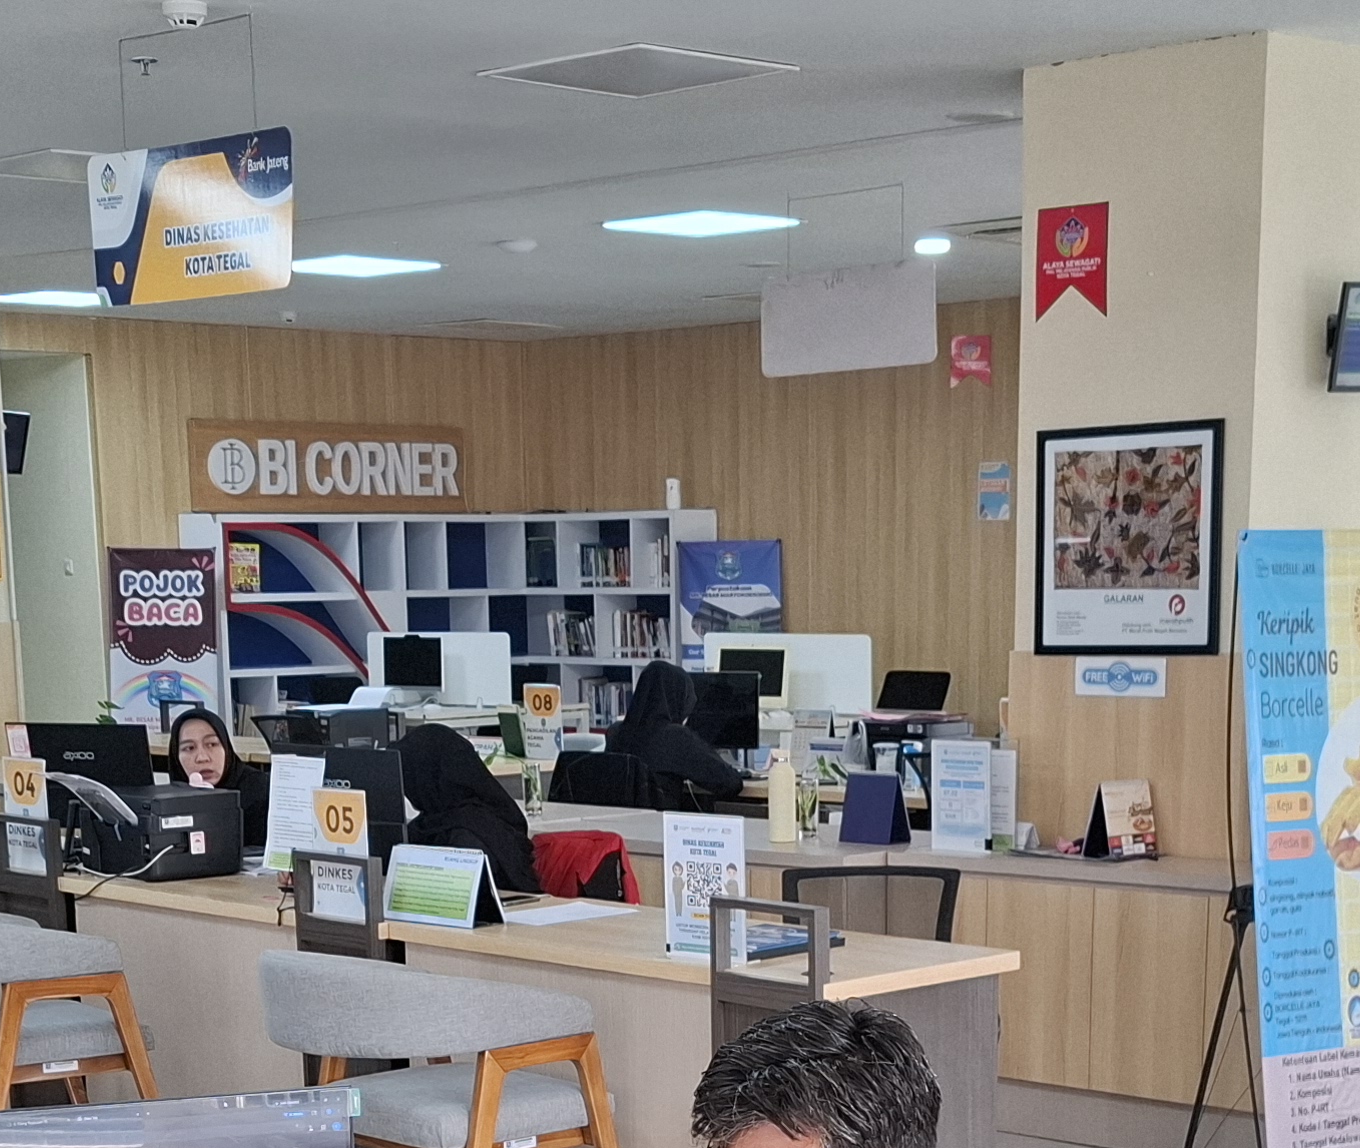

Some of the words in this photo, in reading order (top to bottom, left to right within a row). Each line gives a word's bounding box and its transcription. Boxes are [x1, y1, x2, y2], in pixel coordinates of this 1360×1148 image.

[247, 158, 265, 172] Bank
[266, 155, 289, 173] Jateng
[164, 225, 200, 246] DINAS
[203, 215, 270, 242] KESEHATAN
[185, 254, 214, 275] KOTA
[216, 252, 251, 271] TEGAL
[1043, 261, 1064, 270] ALAYA
[257, 439, 298, 496] BI
[304, 441, 459, 496] CORNER
[123, 572, 202, 594] POJOK
[1104, 594, 1144, 603] GALARAN
[128, 601, 199, 623] BACA
[1257, 607, 1315, 645] Keripik
[1259, 650, 1338, 678] SINGKONG
[1086, 671, 1108, 683] FREE
[1132, 671, 1154, 683] WiFi
[532, 694, 553, 711] 08
[1261, 690, 1324, 719] Borcelle
[13, 771, 35, 799] 04
[1277, 801, 1293, 811] Keju
[325, 805, 354, 834] 05
[8, 824, 36, 838] DINKES
[318, 865, 353, 880] DINKES
[317, 883, 334, 893] KOTA
[336, 883, 356, 894] TEGAL
[1282, 1055, 1318, 1067] Ketentuan
[1319, 1051, 1339, 1062] Label
[1296, 1072, 1316, 1081] Nama
[1318, 1069, 1340, 1079] Usaha
[1297, 1085, 1332, 1099] Komposisi
[1298, 1106, 1309, 1116] No.
[1299, 1123, 1316, 1133] Kode
[1323, 1118, 1350, 1130] Tanggal
